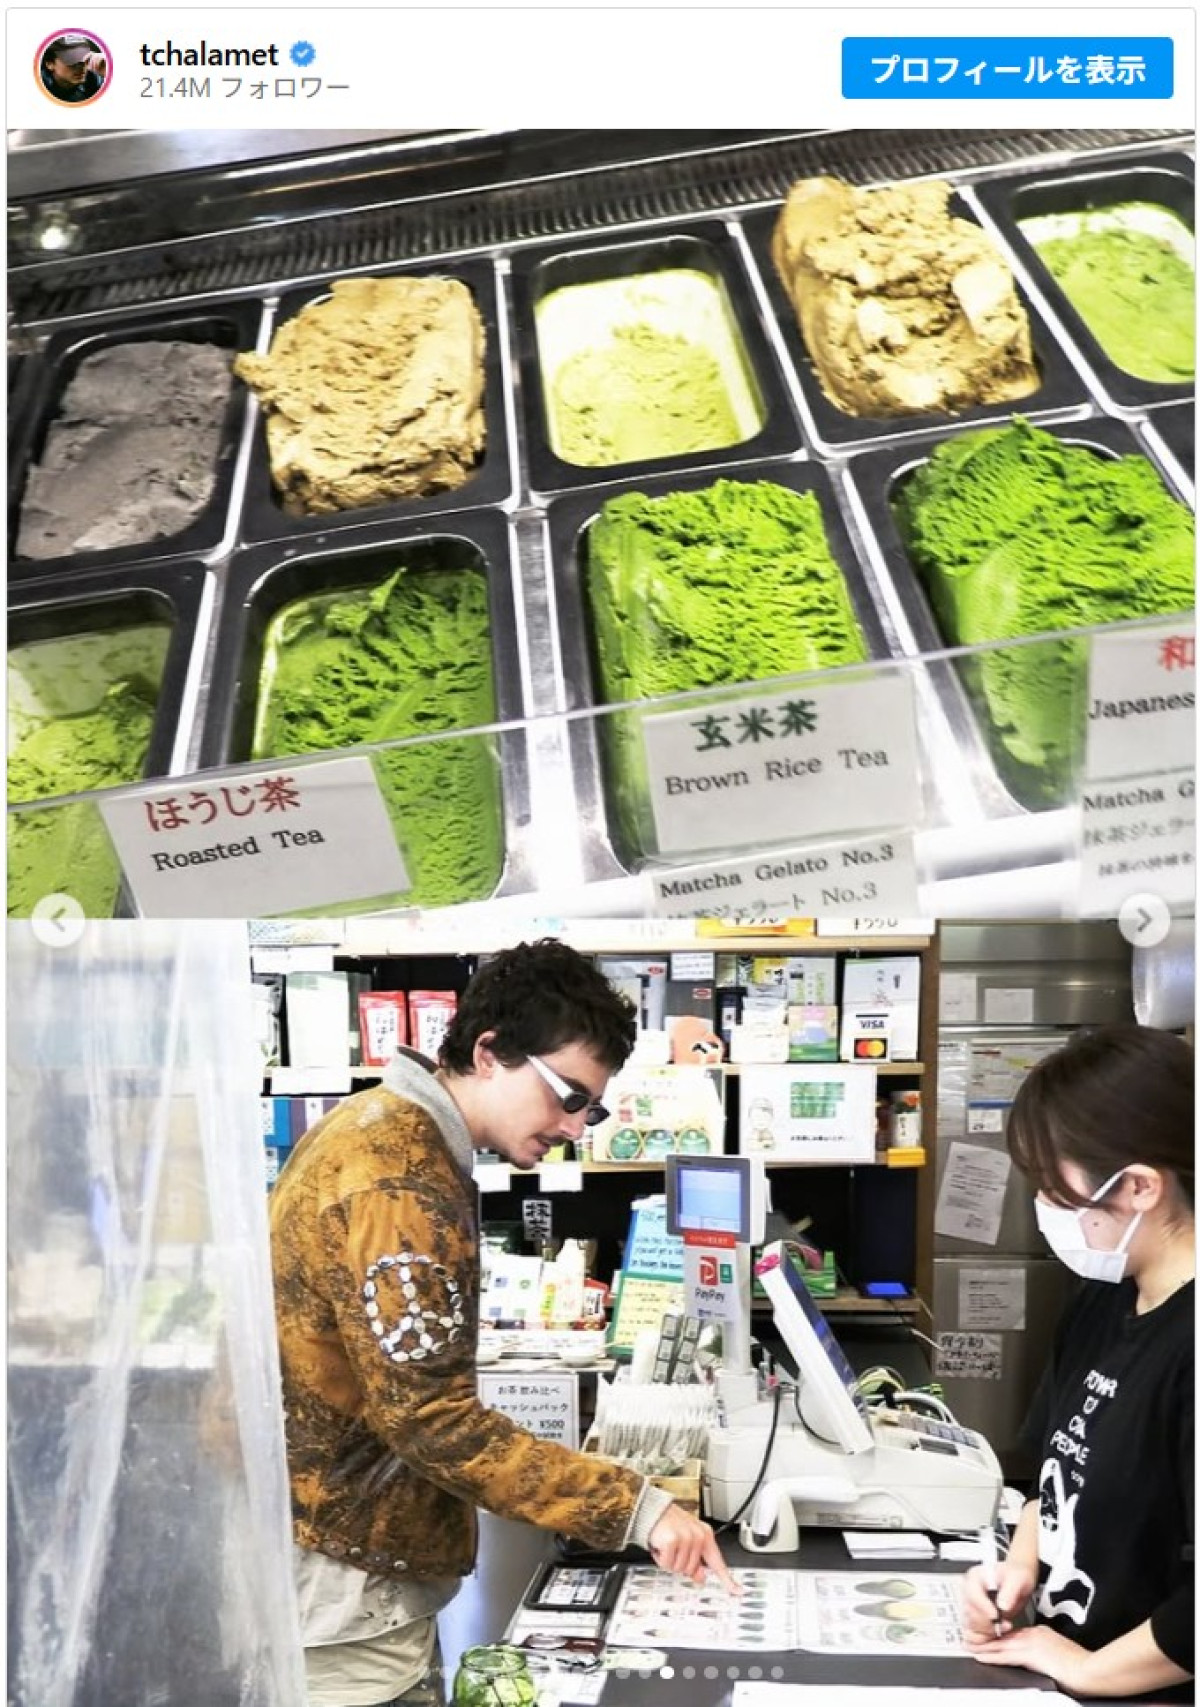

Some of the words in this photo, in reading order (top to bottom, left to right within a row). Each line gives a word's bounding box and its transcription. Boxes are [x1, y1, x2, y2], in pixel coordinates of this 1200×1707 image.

[690, 698, 818, 752] 玄米茶
[665, 770, 749, 796] Brown
[765, 757, 822, 781] Rice
[838, 748, 889, 770] Tea
[144, 776, 300, 832] ほうじ茶
[1082, 785, 1165, 813] Matcha
[151, 837, 261, 872] Roasted
[272, 827, 325, 849] Tea
[660, 870, 742, 898] Matcha
[755, 855, 828, 882] Gelato
[842, 843, 894, 868] No.3
[821, 881, 878, 906] No.3
[860, 1020, 885, 1029] VISA
[525, 1202, 551, 1238] 抹茶
[694, 1287, 725, 1302] PayPay
